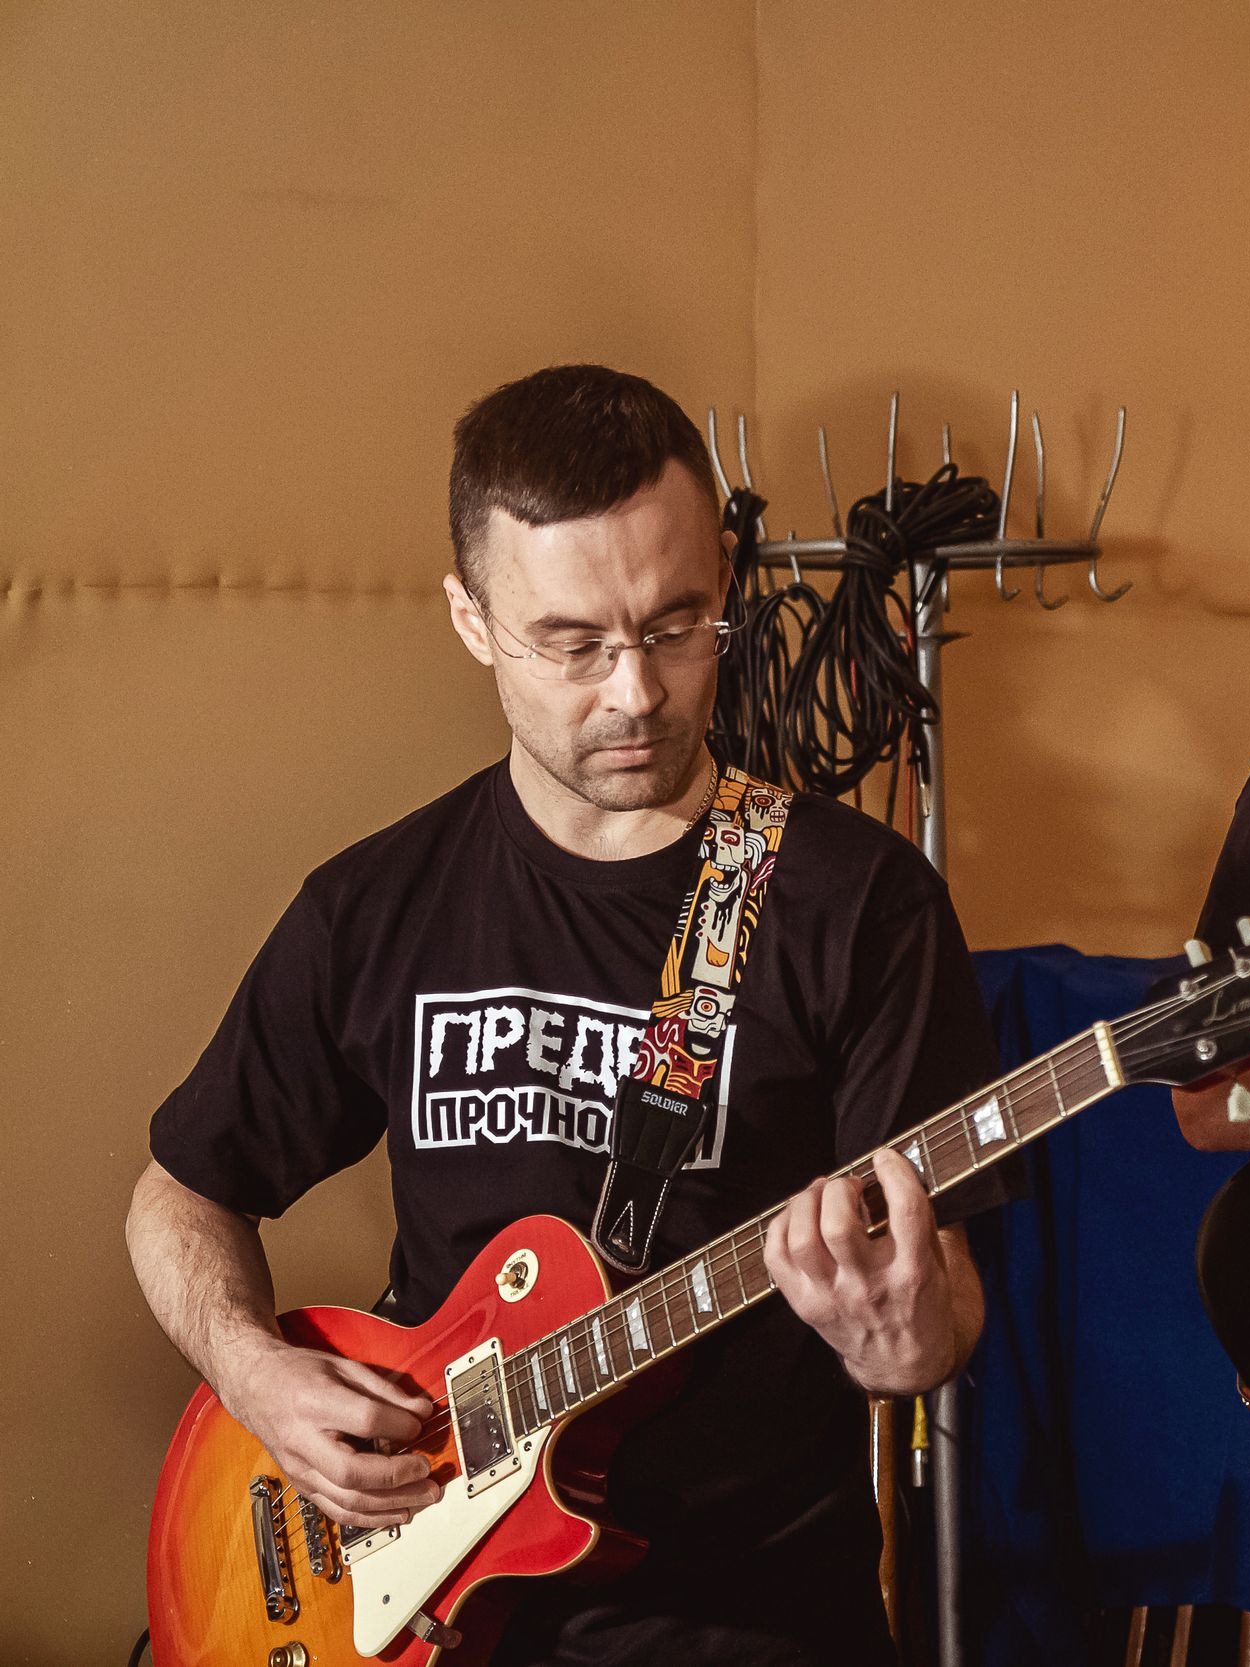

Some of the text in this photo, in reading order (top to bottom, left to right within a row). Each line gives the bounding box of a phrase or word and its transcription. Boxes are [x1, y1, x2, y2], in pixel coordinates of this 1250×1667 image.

[429, 1005, 647, 1098] ПРЕДЕ
[428, 1089, 612, 1153] ПРОЧНО
[641, 1090, 688, 1117] SOLDIER
